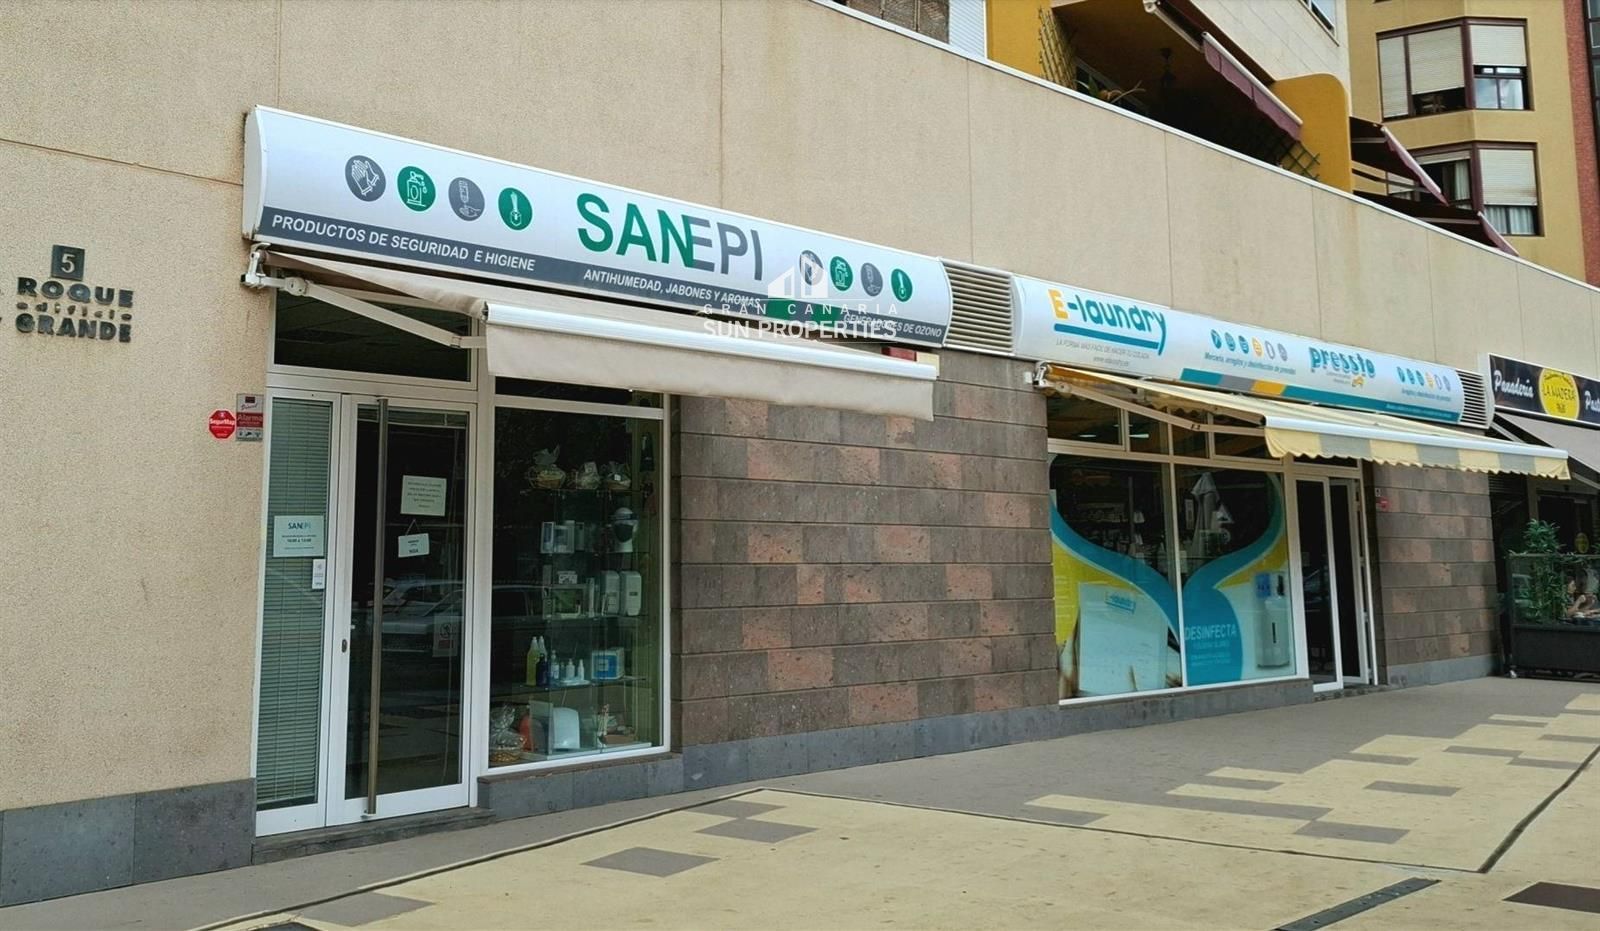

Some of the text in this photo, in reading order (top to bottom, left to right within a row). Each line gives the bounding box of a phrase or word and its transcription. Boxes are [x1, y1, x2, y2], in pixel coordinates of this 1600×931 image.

[272, 214, 536, 272] PRODUCTOS DE SEGURIDAD E HIGIENE
[577, 193, 763, 281] SANEPI
[61, 253, 75, 273] 5
[17, 276, 134, 309] ROQUE
[583, 269, 762, 308] ANTIHUMEDAD, JABONES Y AROMAS
[15, 312, 132, 344] GRANDE
[903, 323, 915, 334] DE
[914, 325, 942, 337] OZONO
[1049, 289, 1167, 356] E-laundry
[1309, 347, 1376, 378] pressto
